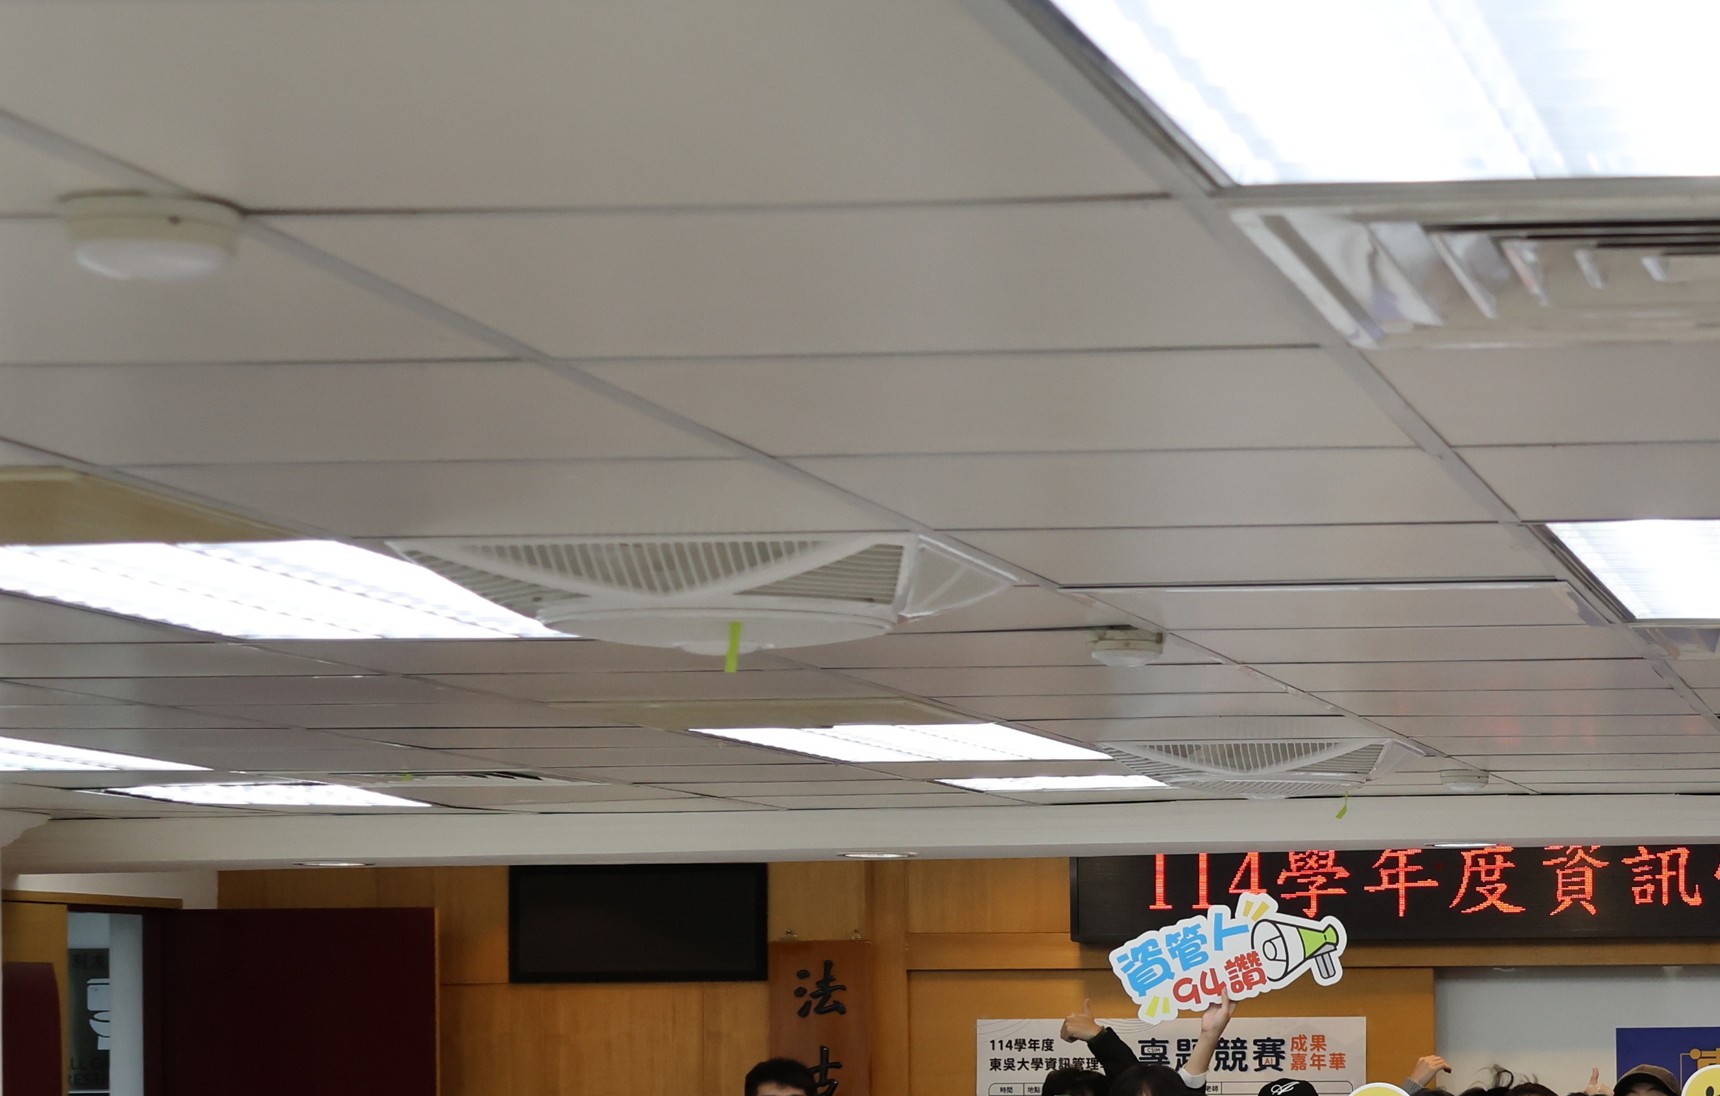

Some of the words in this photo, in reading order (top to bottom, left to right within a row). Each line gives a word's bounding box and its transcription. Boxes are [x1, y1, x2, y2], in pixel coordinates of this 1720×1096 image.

[1116, 913, 1249, 997] 資管人
[1173, 951, 1267, 1004] 94讚
[989, 1038, 1055, 1052] 114學年度
[1290, 1034, 1327, 1052] 成果
[989, 1058, 1104, 1071] 東吳大學資訊管理
[1290, 1053, 1346, 1071] 嘉年華
